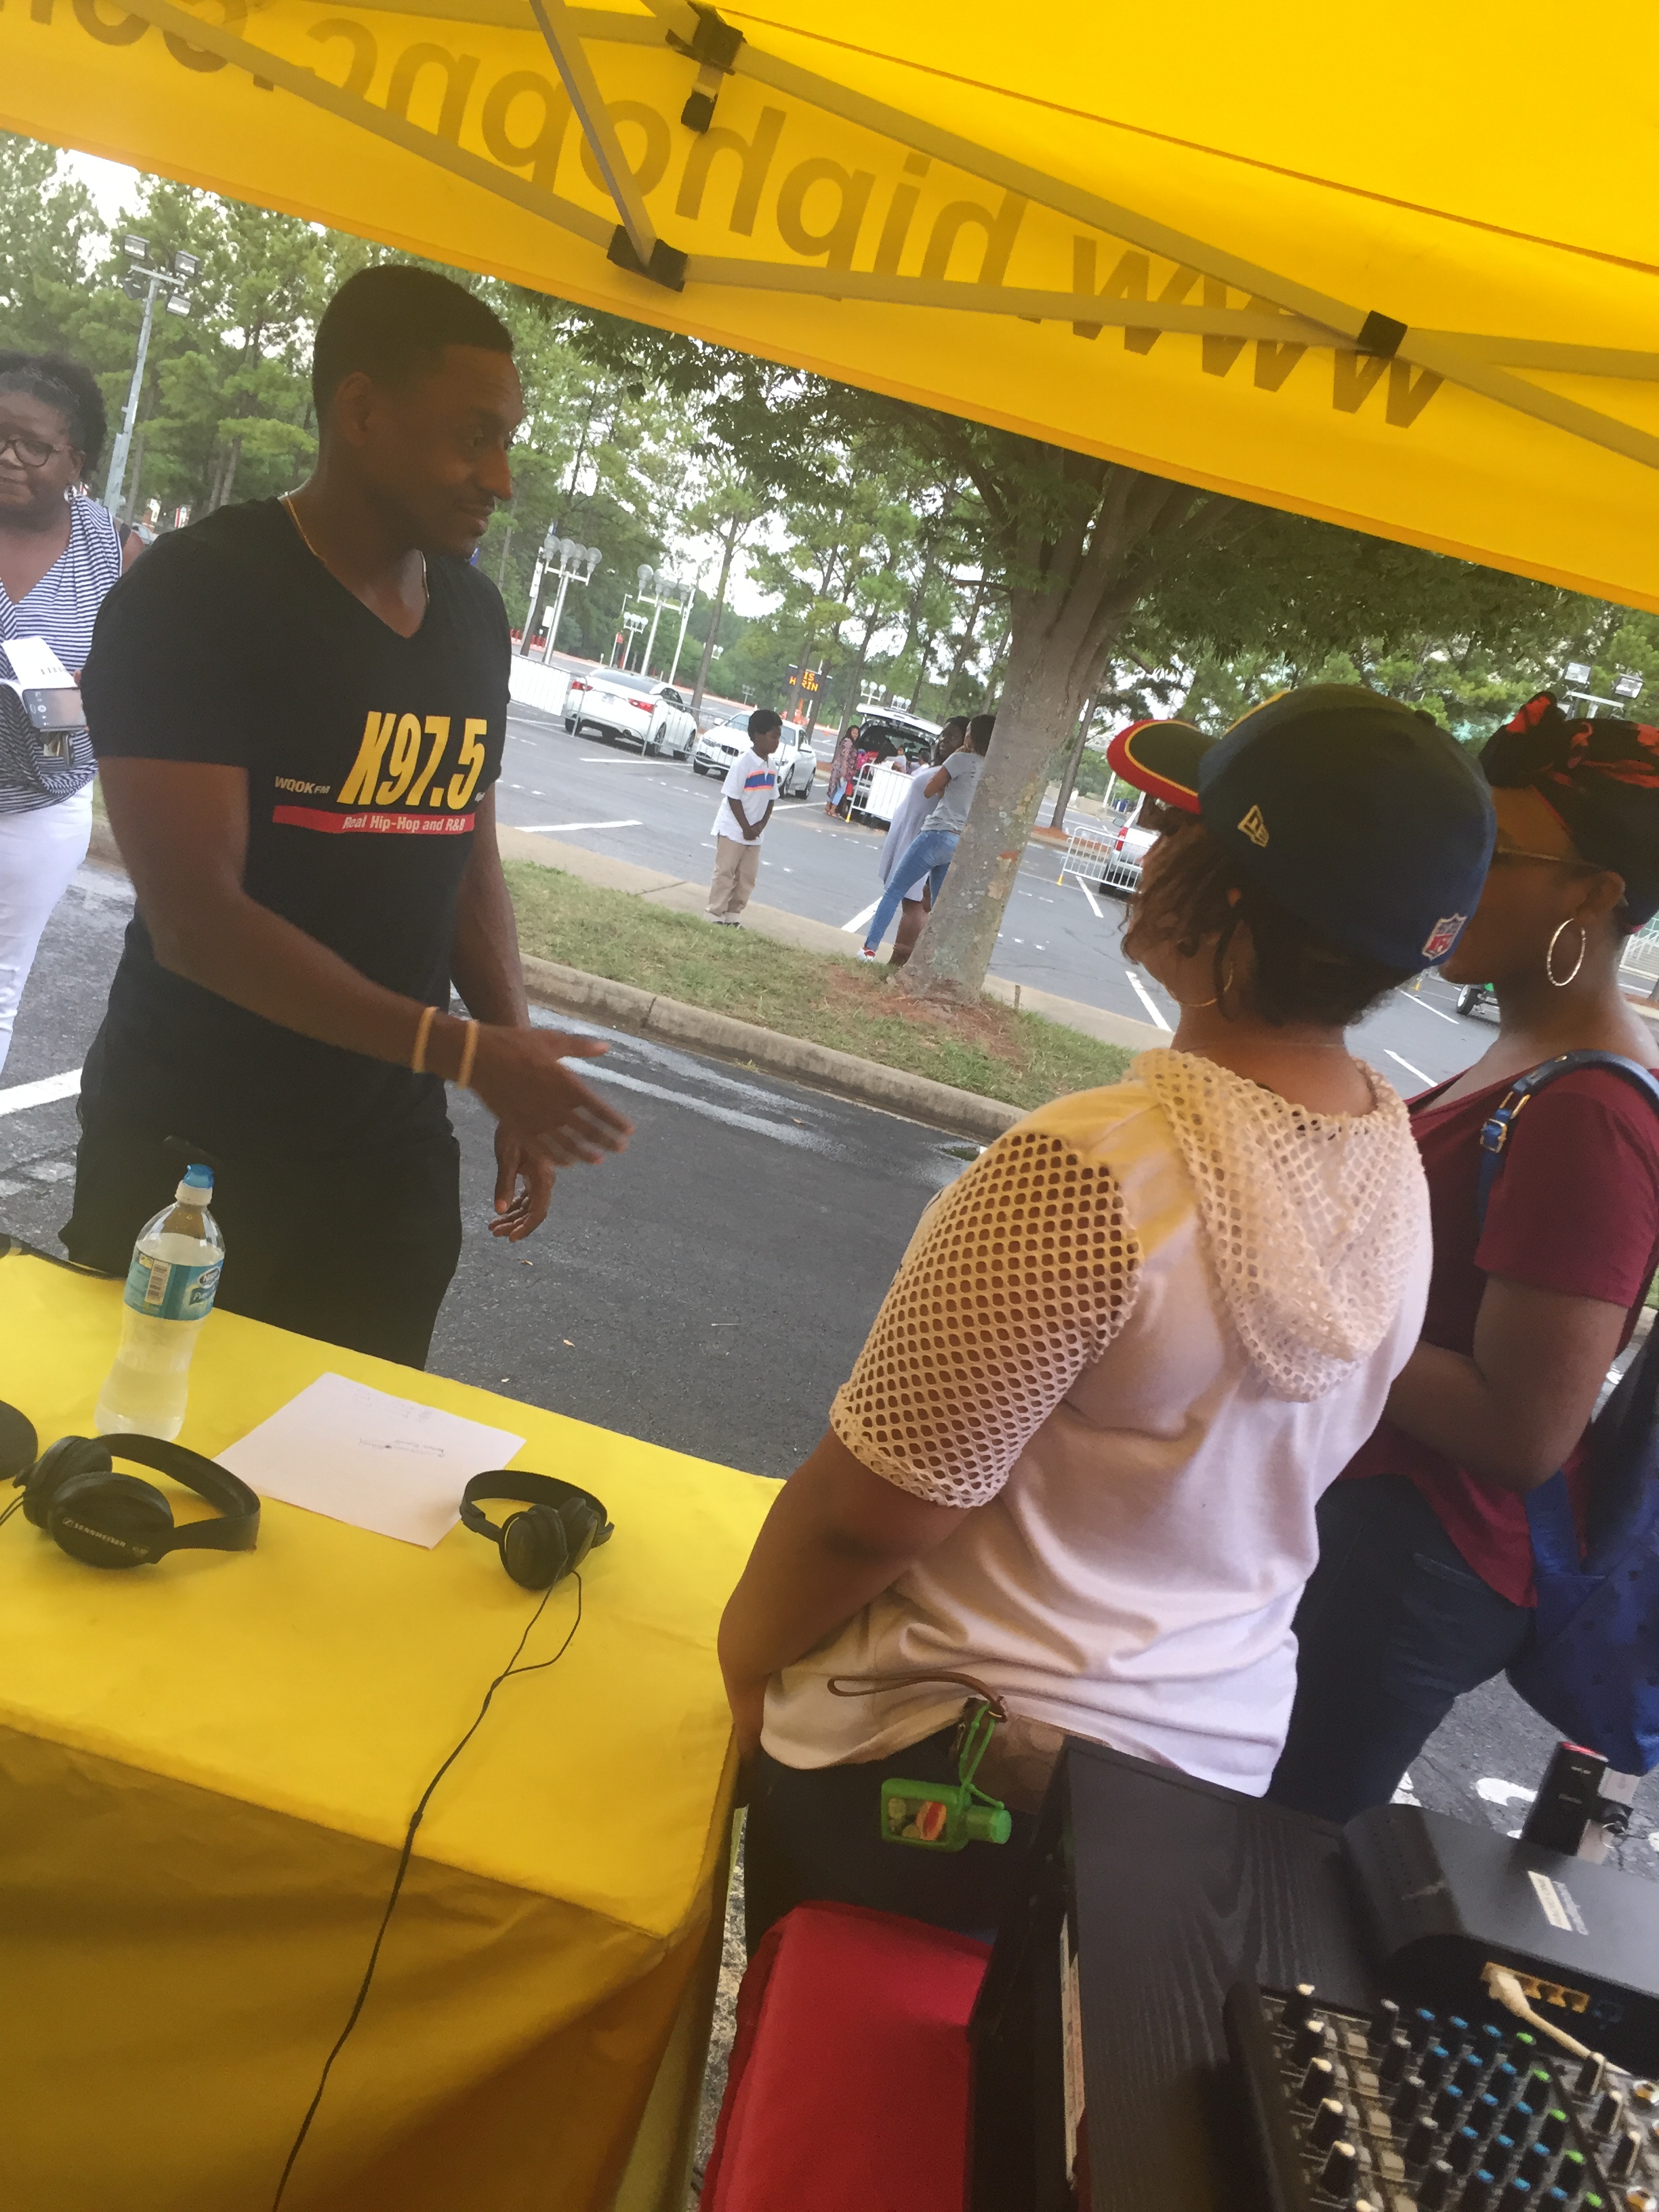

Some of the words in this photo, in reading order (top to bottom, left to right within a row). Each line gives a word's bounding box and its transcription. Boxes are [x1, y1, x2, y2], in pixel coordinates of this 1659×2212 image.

[337, 711, 487, 810] K97.5
[274, 776, 315, 794] WQOK
[314, 785, 331, 794] FM
[342, 815, 367, 829] Real
[370, 815, 419, 833] Hip-Hop
[422, 819, 445, 831] and
[445, 818, 466, 832] R&B
